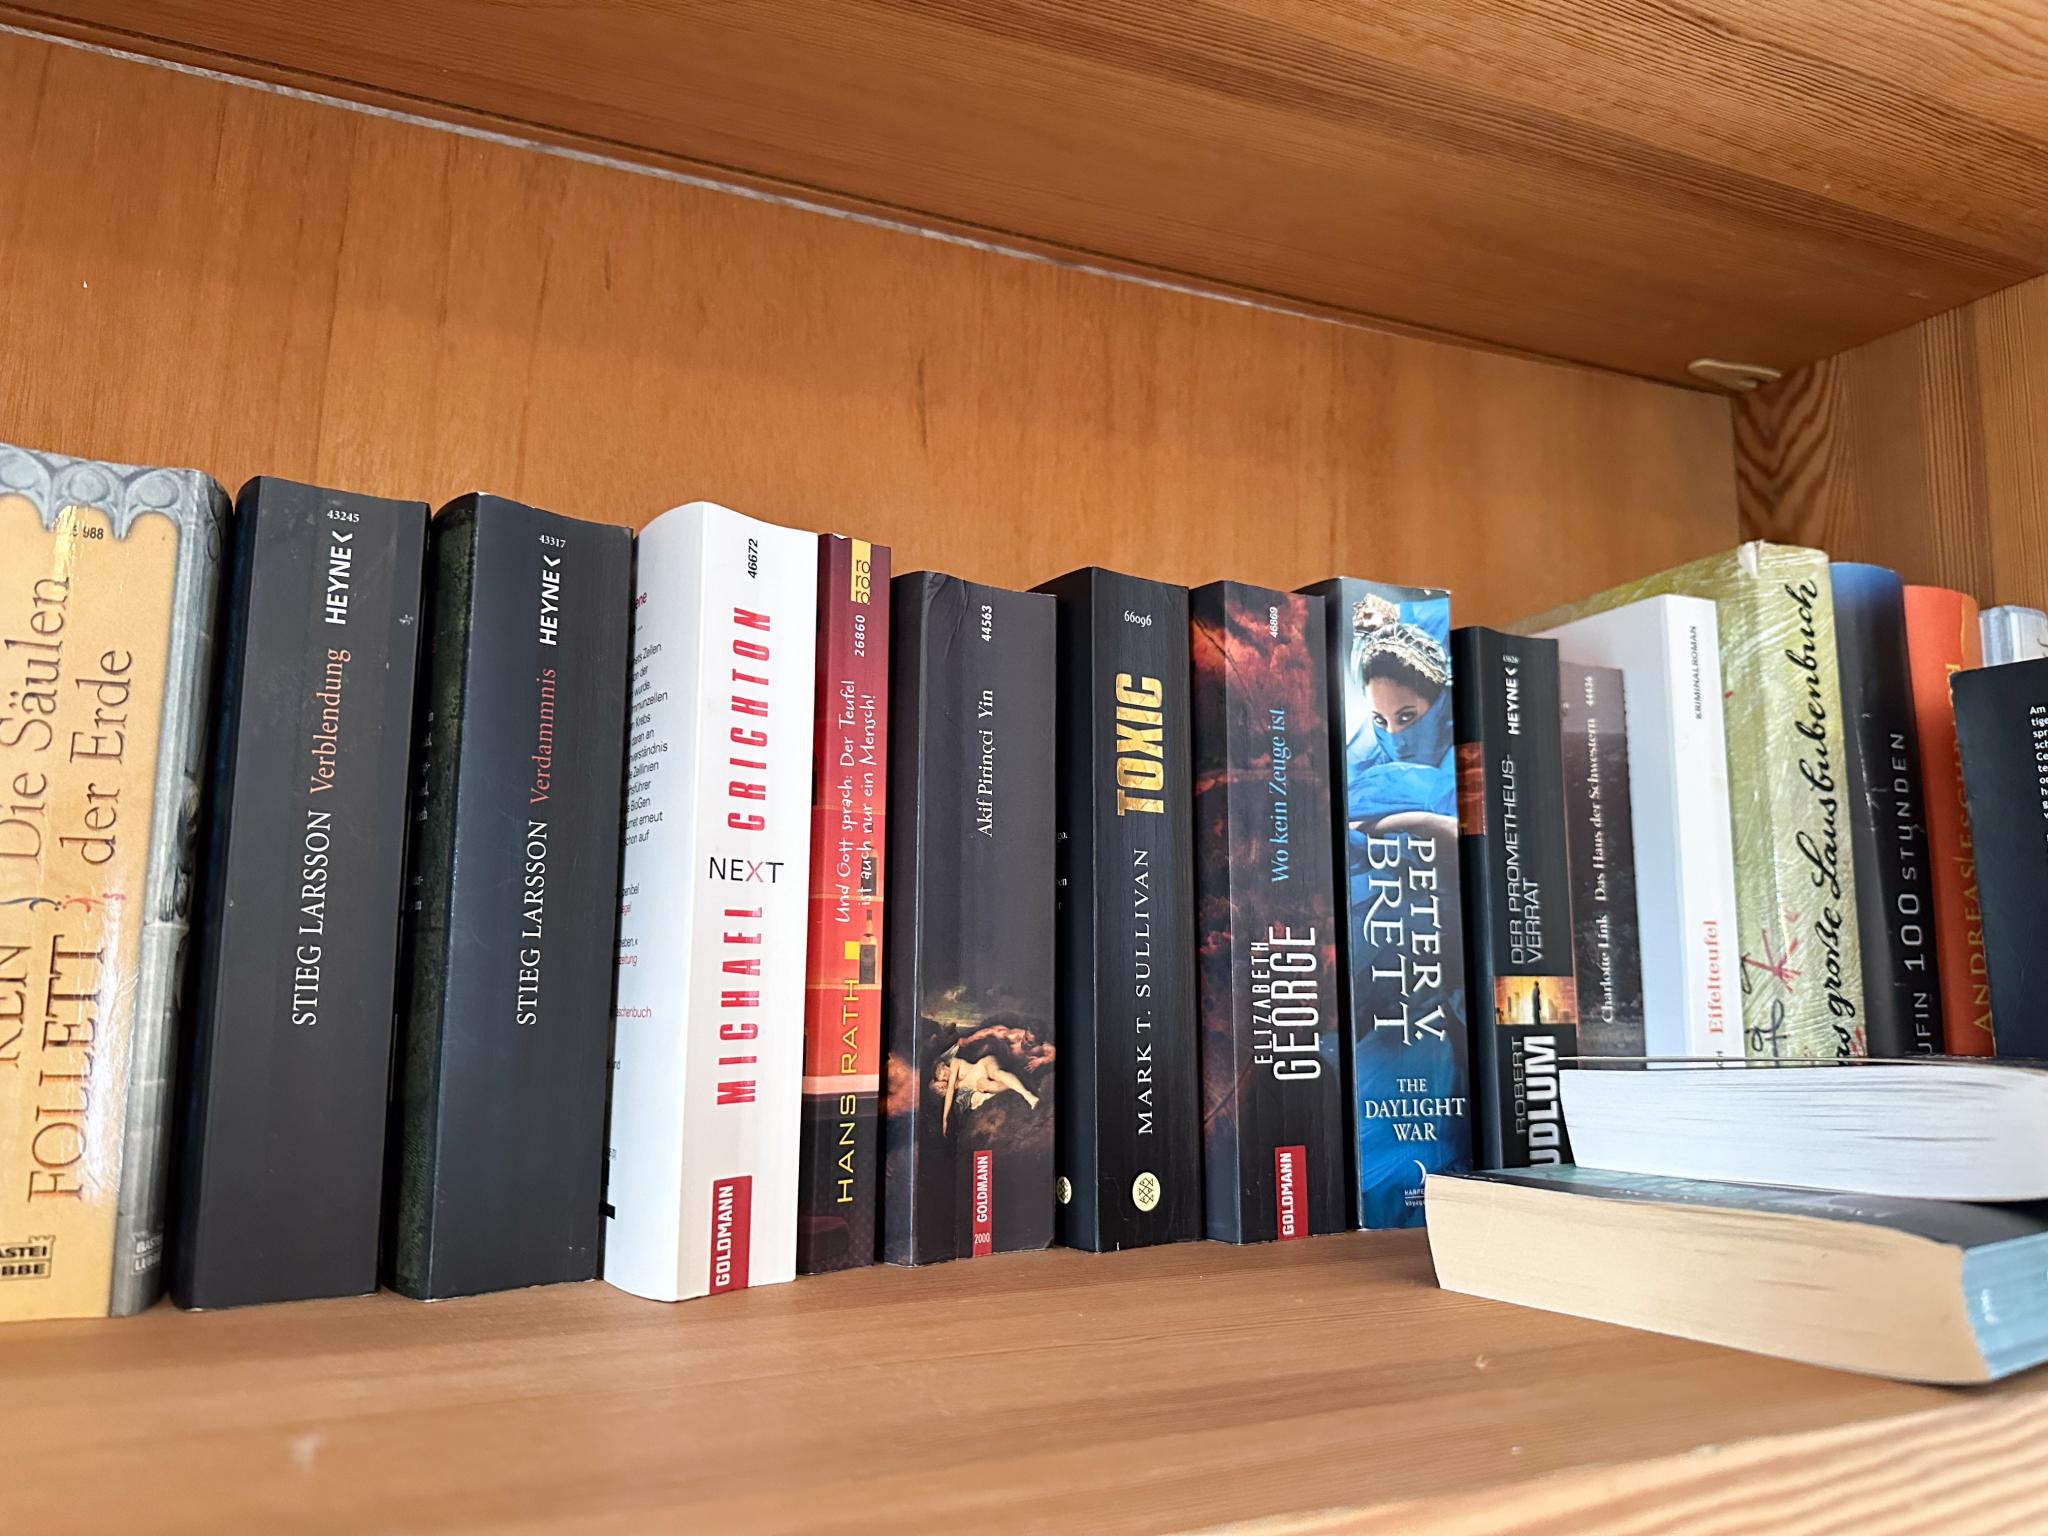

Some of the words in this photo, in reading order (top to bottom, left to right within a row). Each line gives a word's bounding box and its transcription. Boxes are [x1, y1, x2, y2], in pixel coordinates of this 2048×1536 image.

[327, 508, 360, 523] 43245
[539, 534, 566, 548] 43317
[325, 546, 353, 625] HEYNE
[747, 538, 758, 579] 46672
[540, 570, 560, 646] HEYNE
[854, 614, 866, 657] 26860
[981, 605, 993, 642] 44563
[1124, 611, 1152, 628] 66096
[1269, 606, 1278, 638] 46869
[0, 576, 70, 752] Säulen
[1689, 625, 1702, 720] KRIMINALROMAN
[69, 650, 133, 764] Erde
[310, 647, 351, 795] Verblendung
[530, 667, 557, 805] Verdammnis
[727, 607, 771, 831] CRICHTON
[839, 680, 856, 729] Teufel
[859, 694, 877, 766] Mensch!
[978, 689, 993, 719] Yin
[1268, 706, 1285, 732] ist
[1505, 678, 1520, 735] HEYNE
[2029, 705, 2046, 716] Am
[840, 736, 855, 766] Der
[977, 729, 996, 797] Pirinçci
[1115, 672, 1165, 816] TOXIC
[1268, 739, 1292, 797] Zeuge
[1587, 718, 1600, 799] Schwestern
[1785, 577, 1842, 900] Lausbubenbuch
[837, 775, 858, 832] sprach:
[861, 772, 874, 797] ein
[977, 797, 993, 838] Akif
[1590, 803, 1602, 827] der
[1890, 733, 1916, 881] STUNDEN
[60, 782, 121, 865] der
[862, 805, 873, 834] nur
[1269, 800, 1288, 847] kein
[1501, 753, 1522, 913] PROMETHEUS-
[1592, 831, 1604, 869] Haus
[300, 810, 332, 936] LARSSON
[522, 820, 549, 939] LARSSON
[709, 857, 784, 884] NEXT
[837, 838, 854, 877] Gott
[857, 840, 873, 880] auch
[1271, 848, 1289, 884] Wo
[1594, 871, 1607, 901] Das
[835, 884, 850, 923] Und
[857, 886, 872, 906] ist
[1134, 848, 1151, 998] SULLIVAN
[1407, 836, 1442, 993] PETER
[1522, 877, 1542, 964] VERRAT
[1364, 833, 1412, 1047] BRETT
[1510, 918, 1525, 964] DER
[1596, 913, 1610, 948] Link
[1897, 893, 1926, 971] 100
[293, 944, 322, 1027] STIEG
[517, 947, 541, 1025] STIEG
[717, 906, 762, 1105] MICHAEL
[1251, 941, 1273, 1064] ELIZABETH
[1269, 926, 1321, 1081] GEORGE
[1599, 952, 1615, 1024] Charlotte
[1704, 920, 1724, 1034] Eifelteufel
[841, 979, 860, 1075] RATH
[1137, 1010, 1151, 1032] T.
[1413, 1005, 1446, 1042] V.
[27, 934, 106, 1202] FOLLETT
[1138, 1043, 1153, 1135] MARK
[1397, 1078, 1428, 1093] THE
[1511, 1036, 1526, 1135] ROBERT
[1524, 1035, 1561, 1168] UDLUM
[1364, 1097, 1466, 1119] DAYLIGHT
[1392, 1122, 1437, 1142] WAR
[837, 1094, 856, 1204] HANS
[977, 1155, 988, 1223] GOLDMANN
[1279, 1152, 1292, 1236] GOLDMANN
[716, 1185, 734, 1286] GOLDMANN
[974, 1232, 990, 1245] 2000
